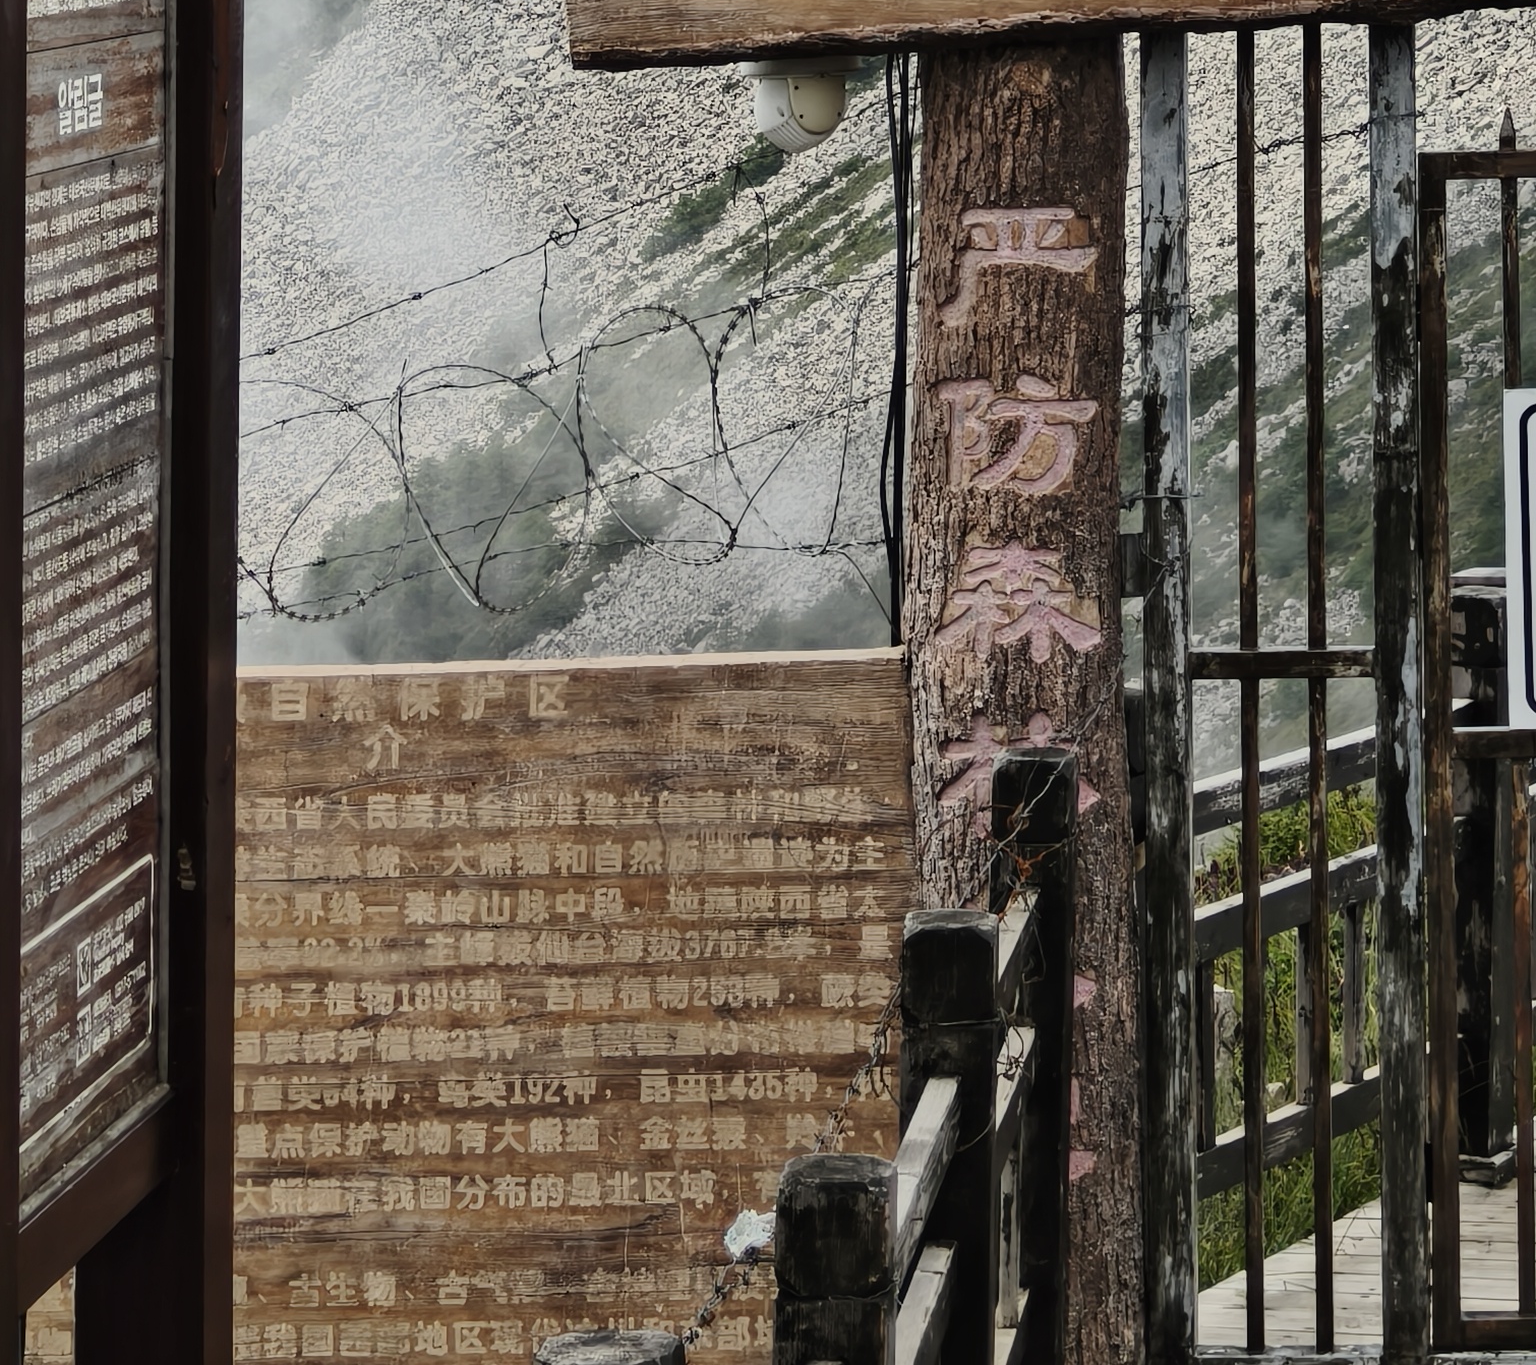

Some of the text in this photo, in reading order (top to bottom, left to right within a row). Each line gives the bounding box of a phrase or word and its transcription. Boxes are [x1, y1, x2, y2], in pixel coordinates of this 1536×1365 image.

[236, 673, 570, 722] 自然保护区
